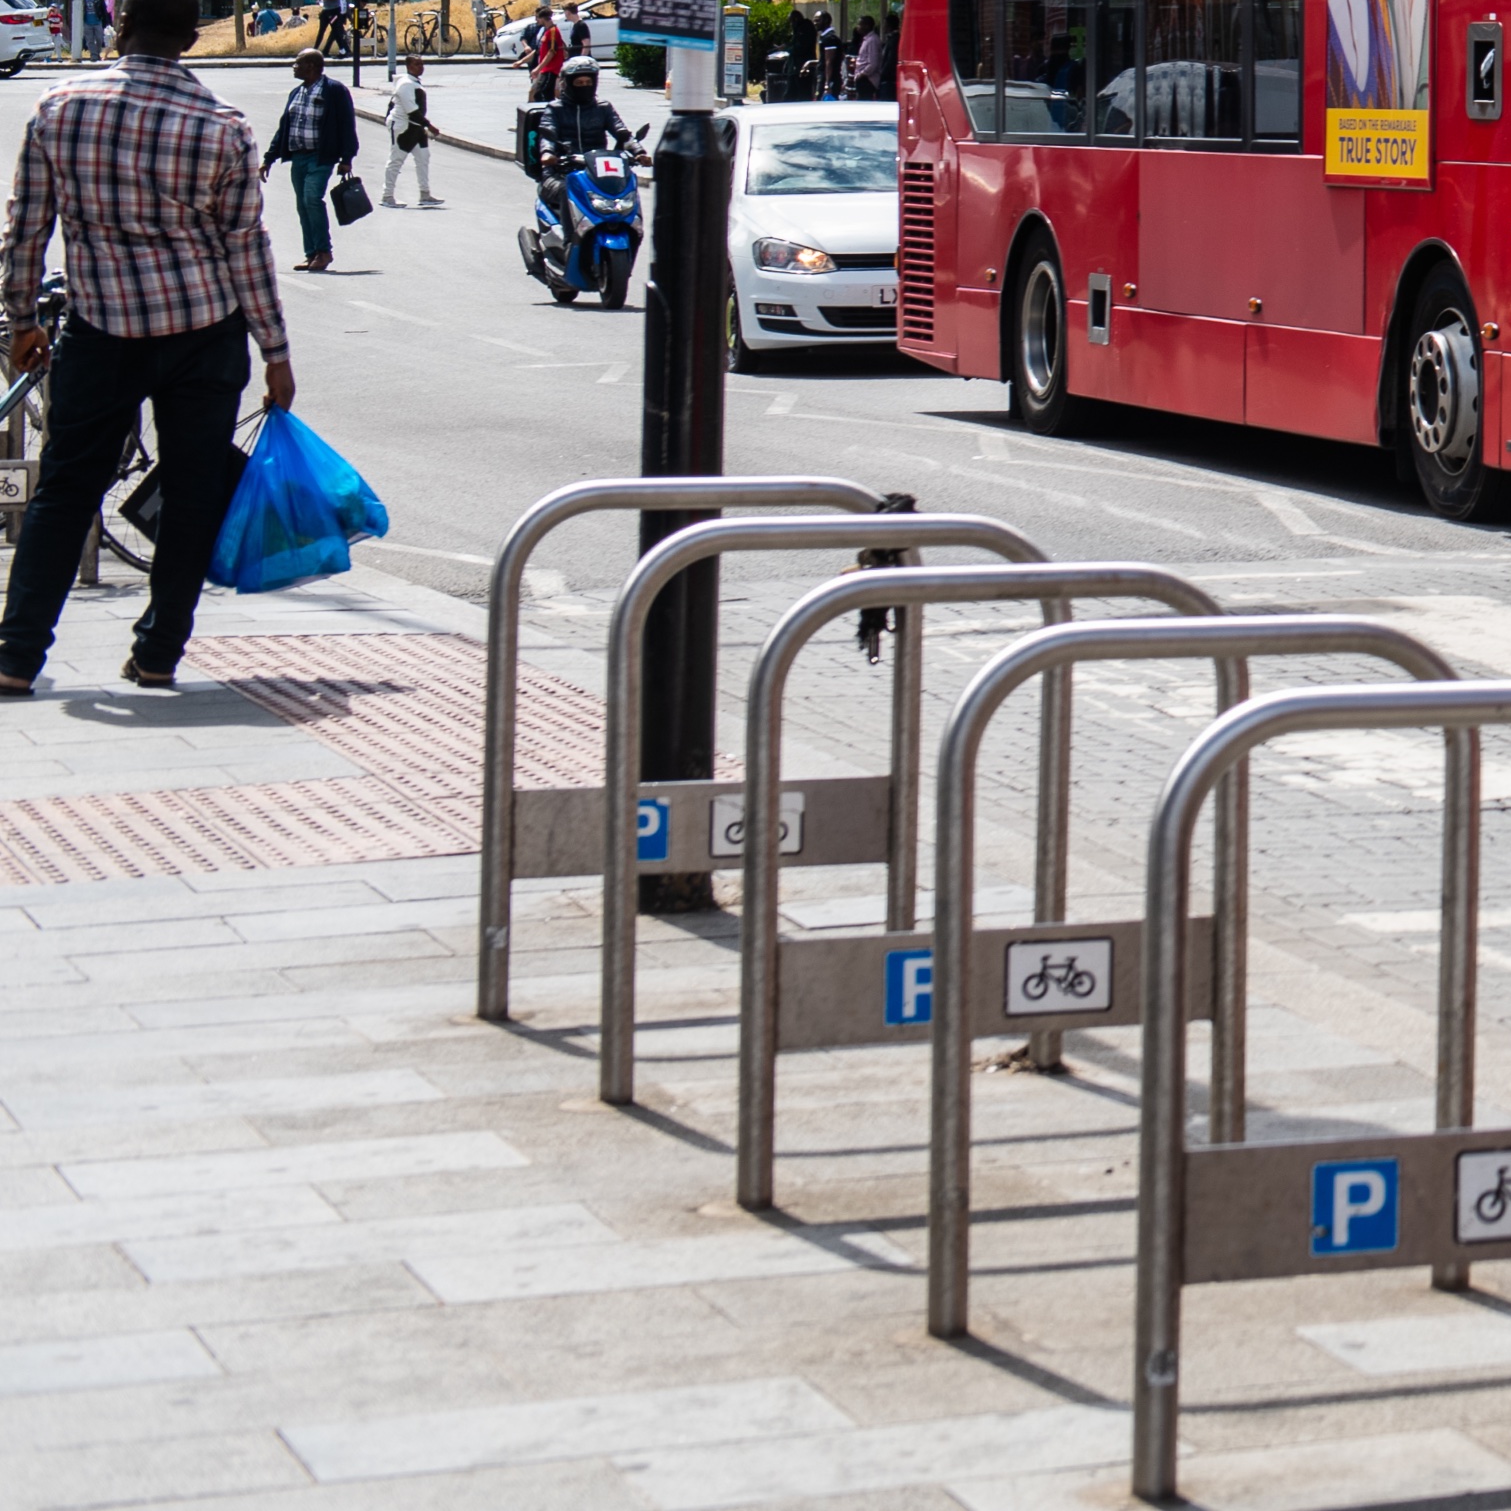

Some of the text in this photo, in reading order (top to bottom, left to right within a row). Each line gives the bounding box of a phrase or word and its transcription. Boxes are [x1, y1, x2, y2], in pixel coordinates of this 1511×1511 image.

[1339, 118, 1417, 132] BASED ON THE REMARKABLE
[1339, 137, 1417, 166] TRUE STORY
[604, 160, 618, 172] L
[1332, 1170, 1386, 1247] P
